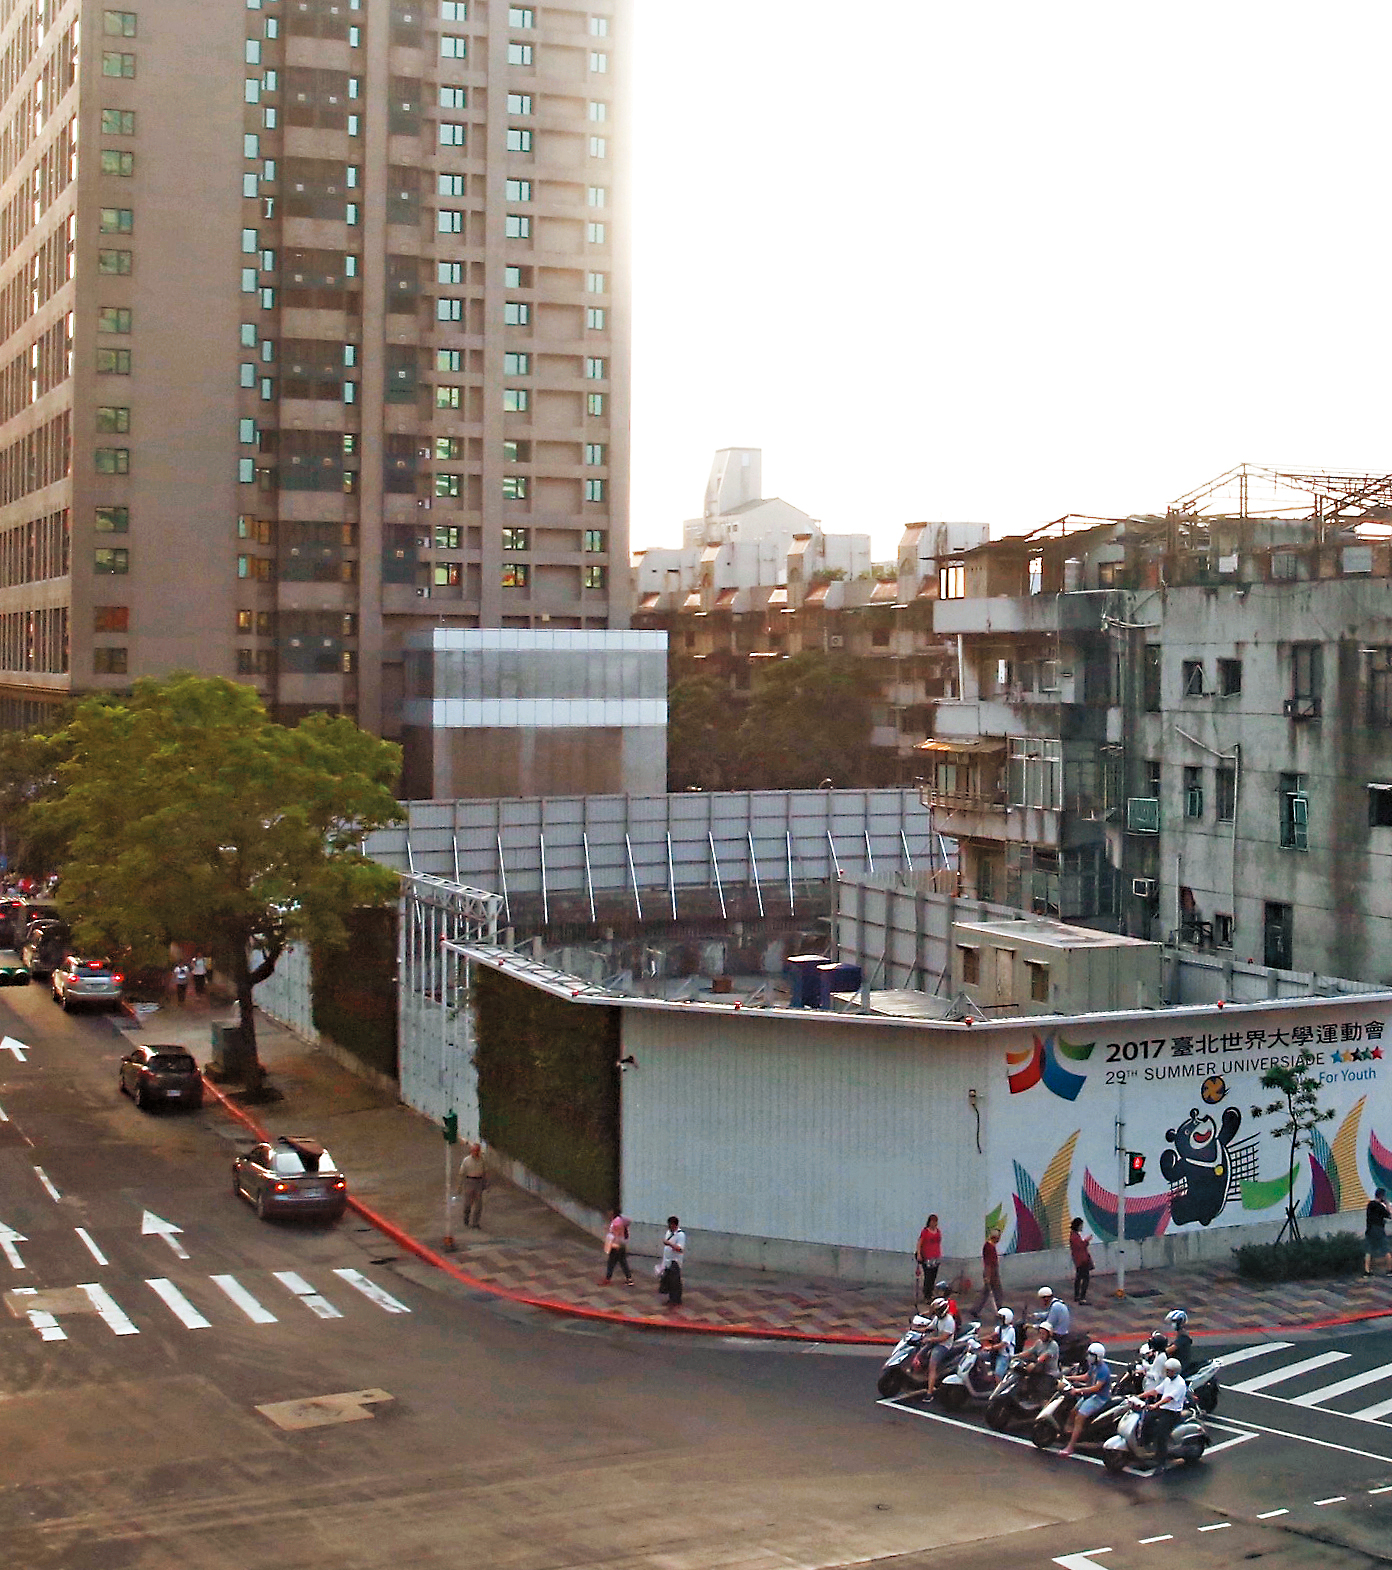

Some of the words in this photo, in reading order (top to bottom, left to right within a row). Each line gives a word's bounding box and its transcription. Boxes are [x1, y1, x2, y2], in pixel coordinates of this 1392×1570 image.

[1105, 1039, 1166, 1063] 2017
[1171, 1020, 1385, 1057] 臺北世界大學運動會
[1144, 1061, 1216, 1082] SUMMER
[1222, 1053, 1325, 1074] UNIVERSIADE
[1319, 1071, 1338, 1084] For
[1341, 1067, 1377, 1082] Youth
